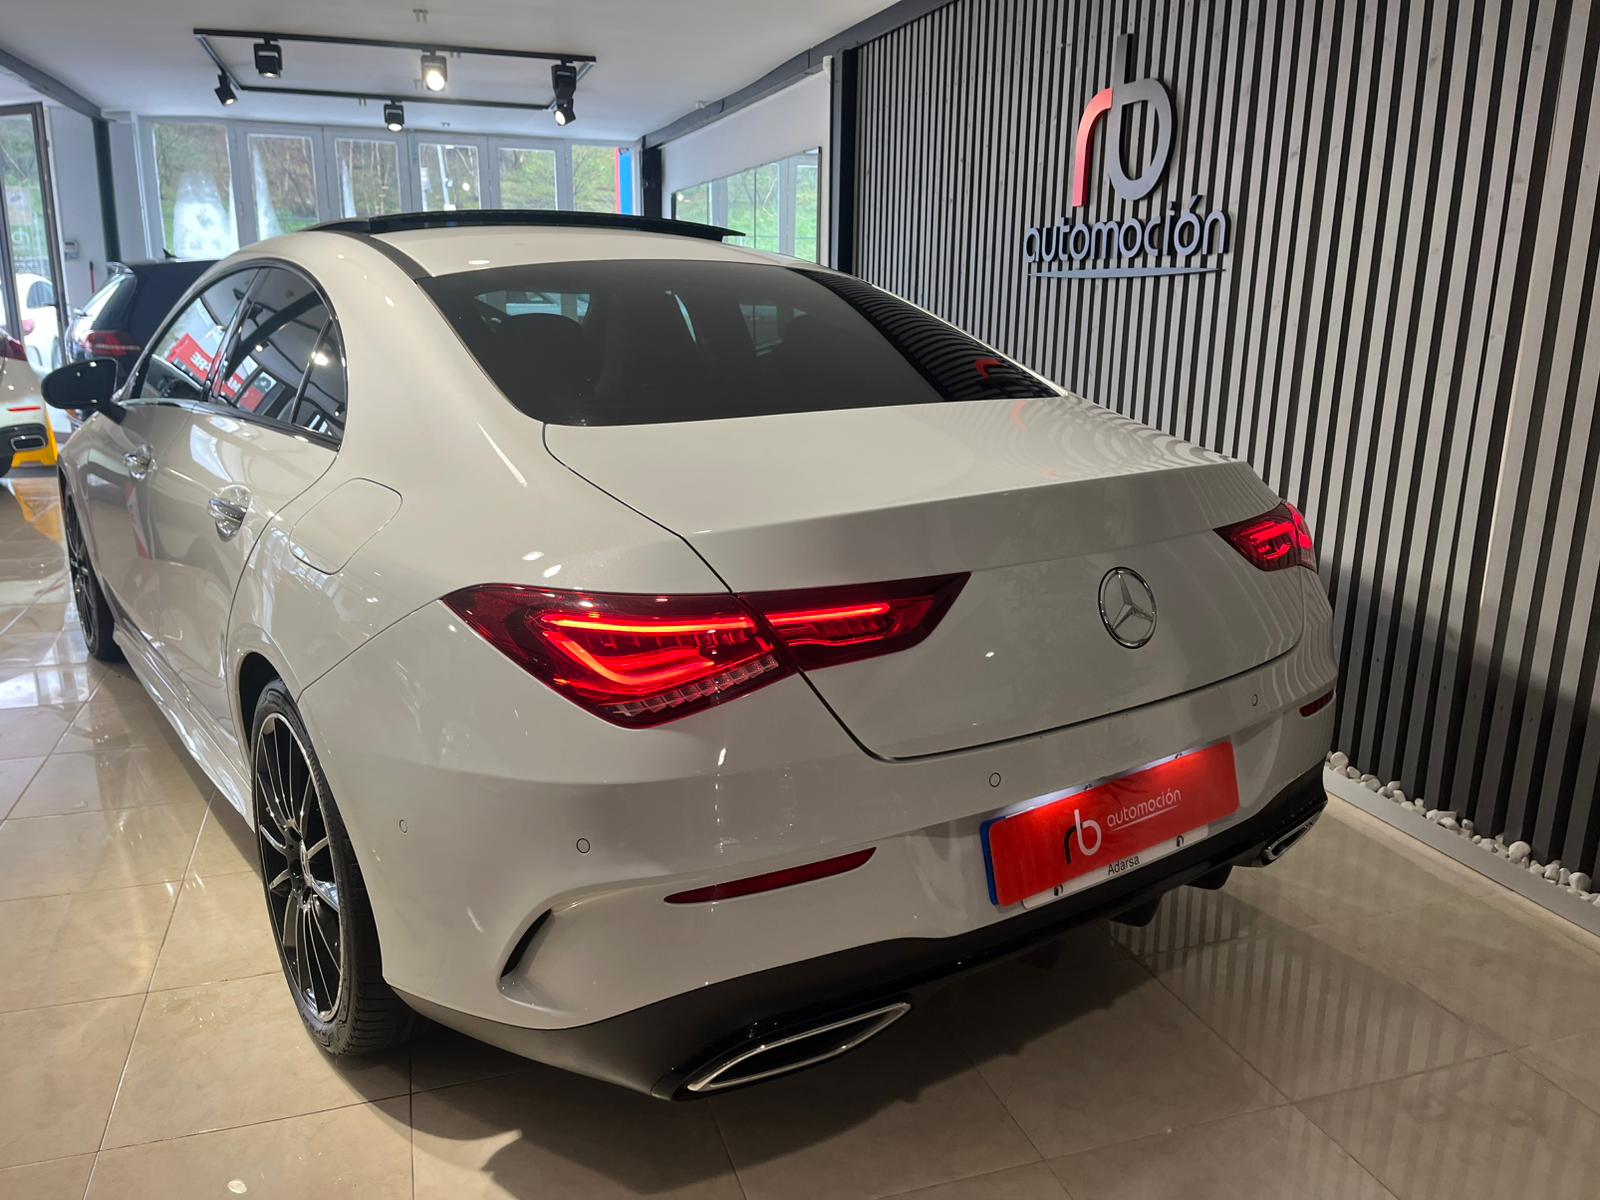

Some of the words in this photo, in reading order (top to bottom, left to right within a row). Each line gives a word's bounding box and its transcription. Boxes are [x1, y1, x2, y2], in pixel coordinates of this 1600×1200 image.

[1023, 194, 1228, 263] automoción
[1107, 788, 1181, 827] automoción
[1108, 855, 1140, 876] Adarsa
